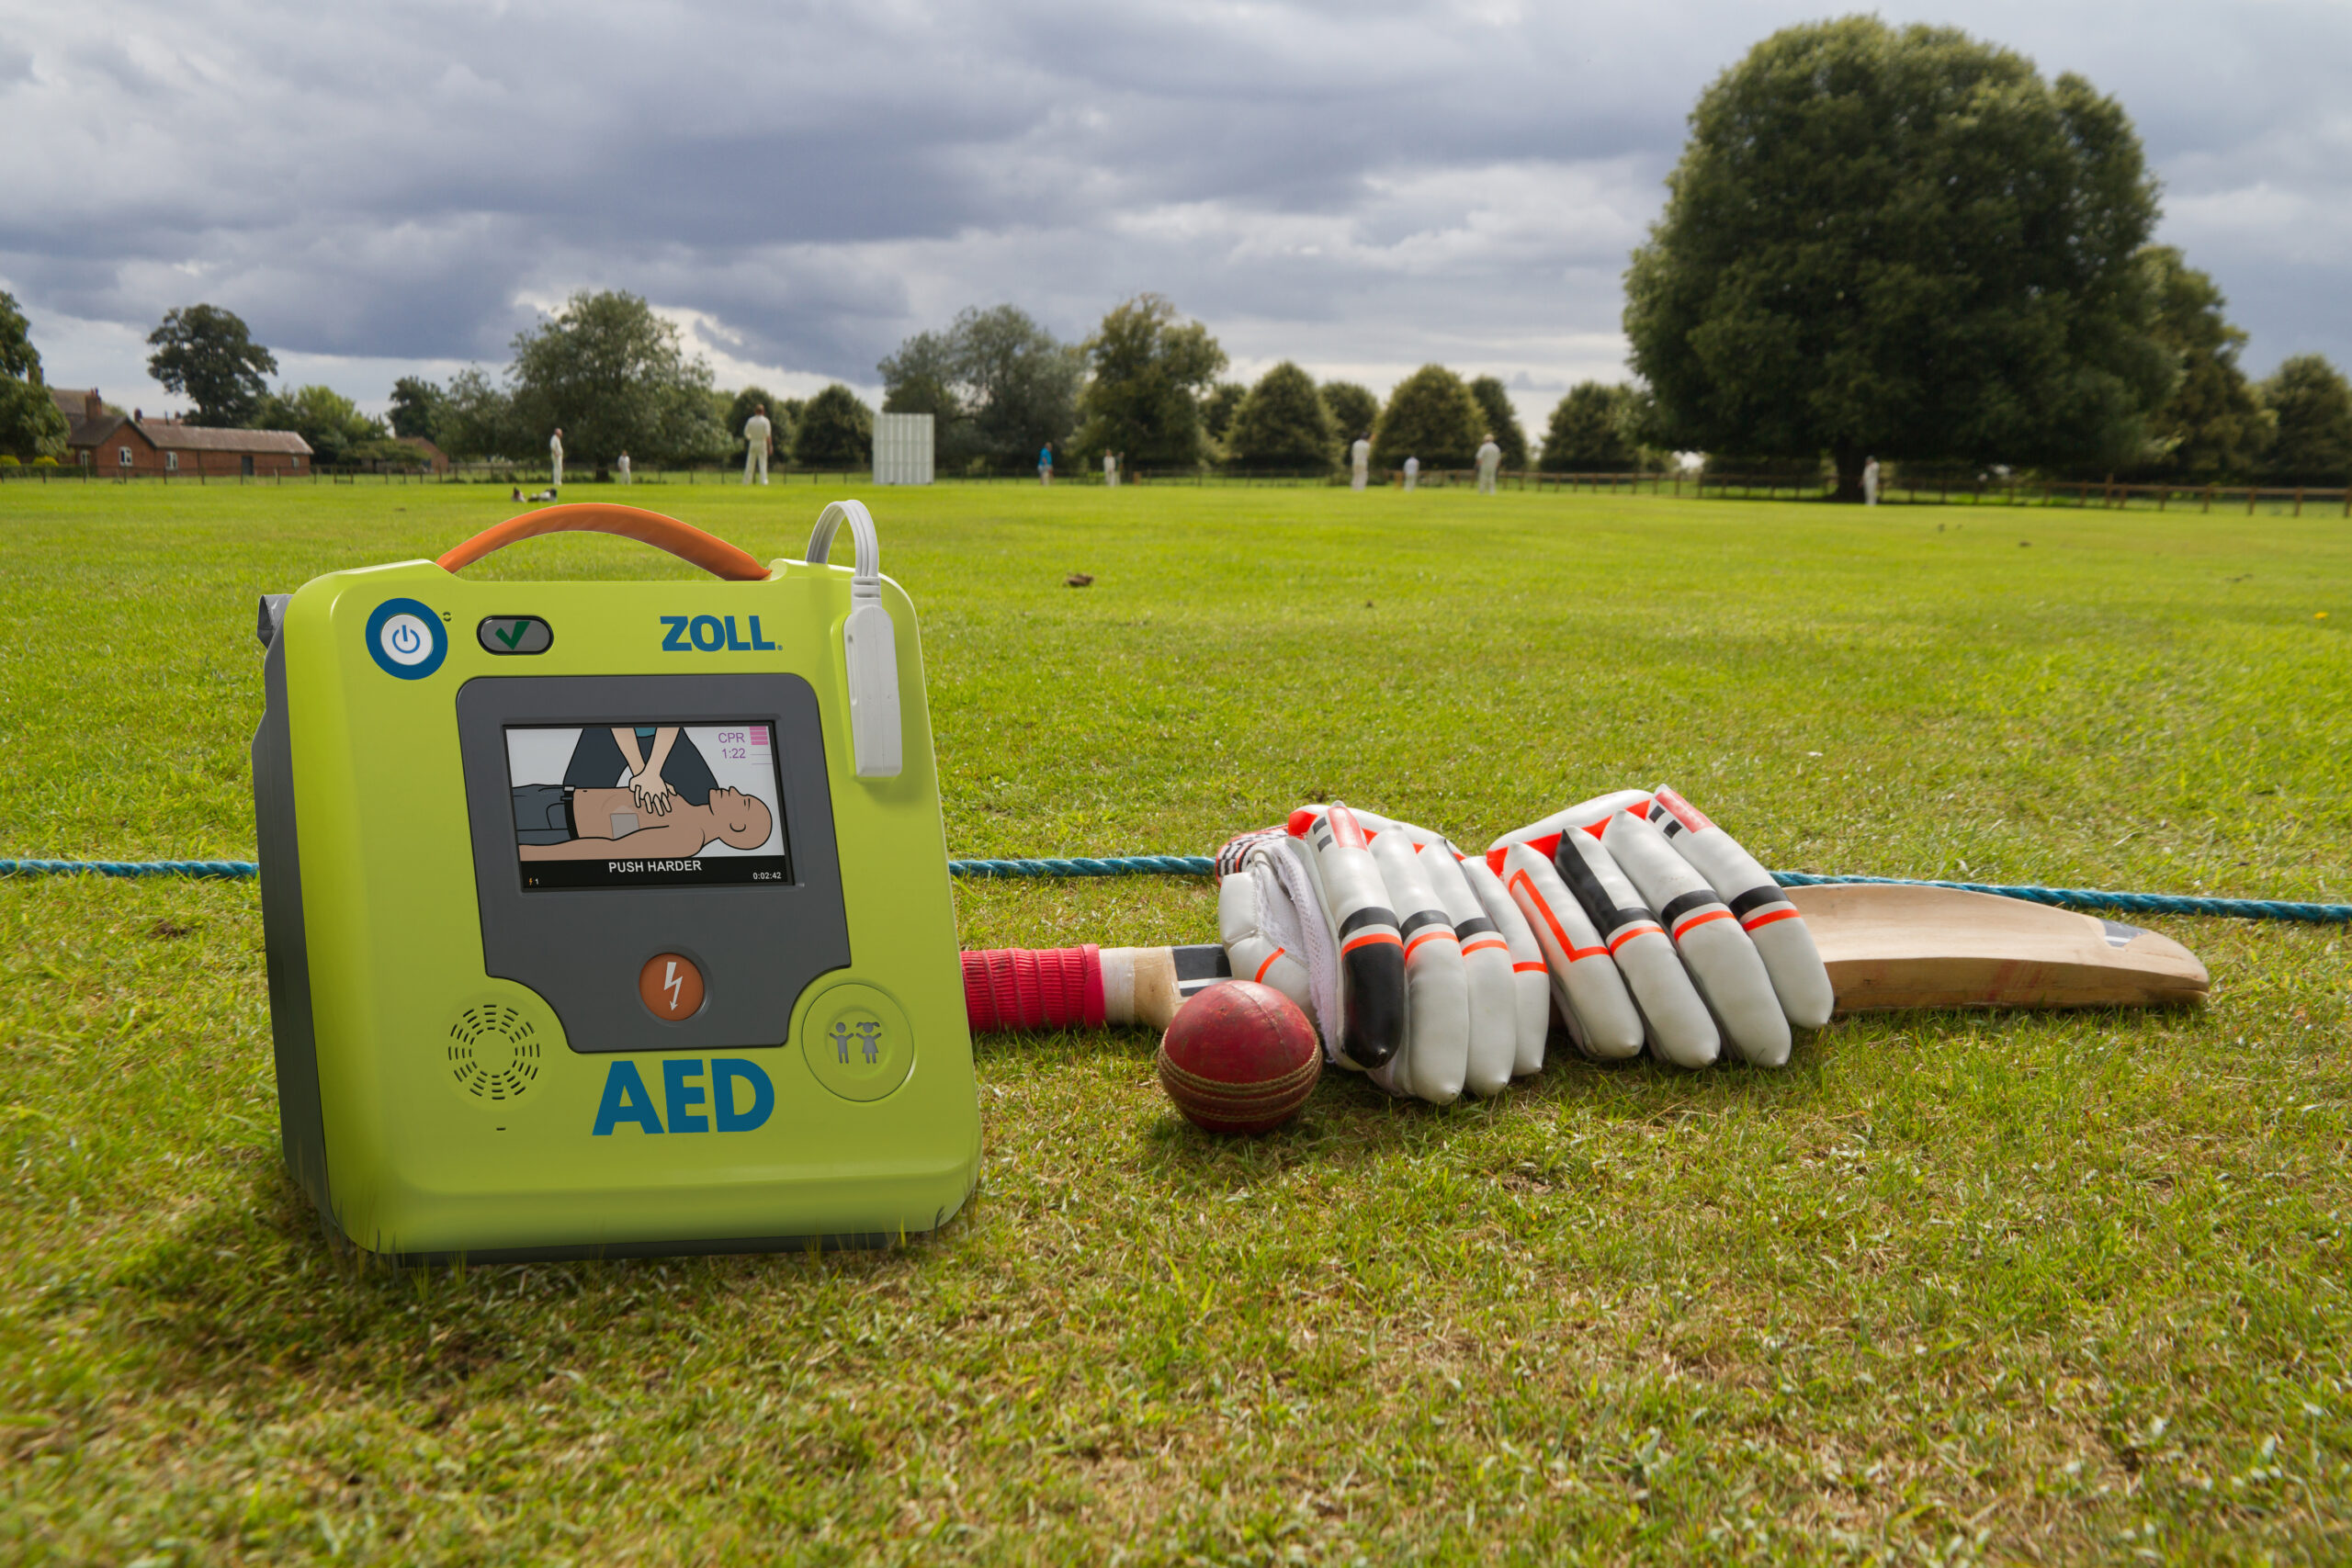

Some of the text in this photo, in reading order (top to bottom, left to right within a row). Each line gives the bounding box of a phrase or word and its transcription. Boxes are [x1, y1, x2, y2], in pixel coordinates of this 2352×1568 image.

[660, 615, 776, 652] ZOLL
[718, 732, 745, 744] CPR
[721, 748, 746, 759] 1:22
[608, 860, 703, 873] PUSH HARDER
[752, 872, 782, 880] 0:02:42
[592, 1058, 775, 1135] AED
